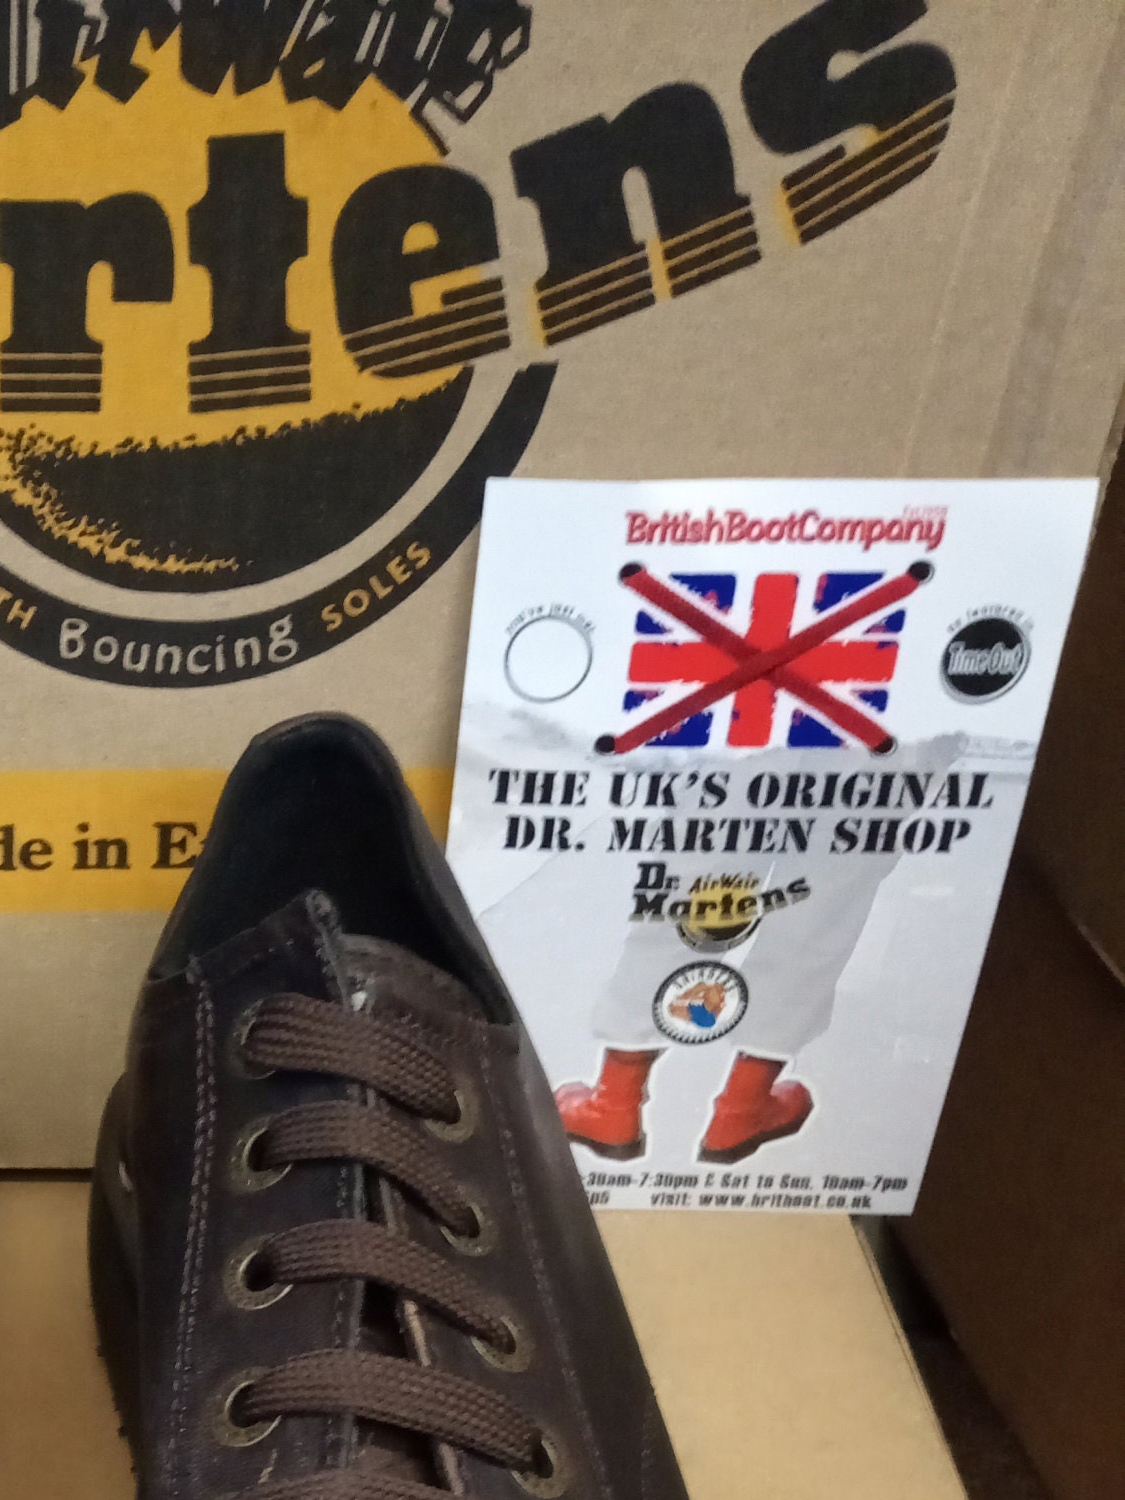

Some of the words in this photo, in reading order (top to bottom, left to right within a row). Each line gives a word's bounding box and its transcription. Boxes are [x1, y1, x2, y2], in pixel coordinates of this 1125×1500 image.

[625, 507, 946, 552] BritishBootCompany
[58, 615, 299, 675] Bouncing
[320, 540, 432, 632] SOLES
[488, 770, 589, 805] THE
[608, 772, 730, 808] UK'S
[745, 771, 995, 809] ORIGINAL
[71, 822, 131, 870] in
[150, 822, 210, 870] E
[503, 817, 586, 850] DR.
[606, 817, 816, 853] MARTEN
[828, 818, 973, 855] SHOP
[627, 877, 812, 922] Martens
[720, 1173, 750, 1189] Sat
[756, 1174, 774, 1189] to
[822, 1174, 909, 1192] 10am-7pm
